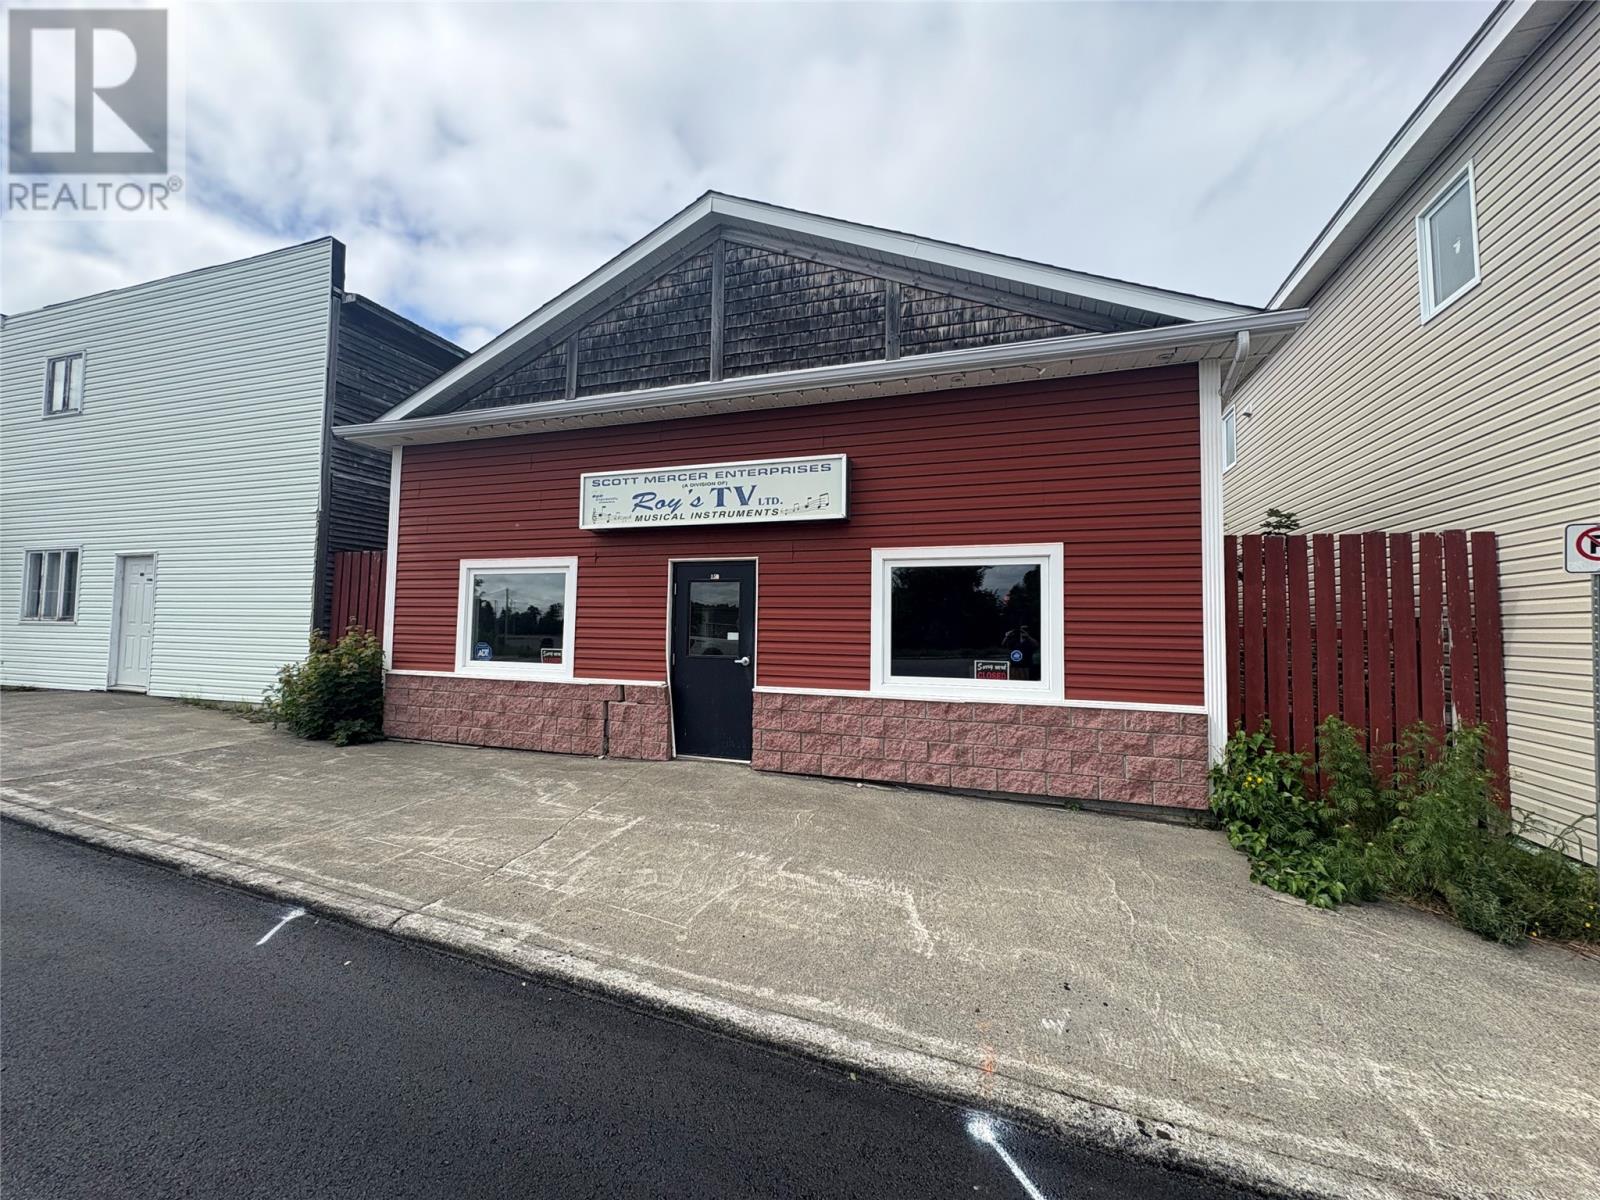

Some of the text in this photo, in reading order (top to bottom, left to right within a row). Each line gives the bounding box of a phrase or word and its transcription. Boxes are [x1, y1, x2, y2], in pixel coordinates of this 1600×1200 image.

[592, 463, 832, 488] SCOTT MERCER ENTERPRISES
[632, 485, 783, 514] Roy's TV LTD.
[635, 508, 779, 522] MUSICAL INSTRUMENTS
